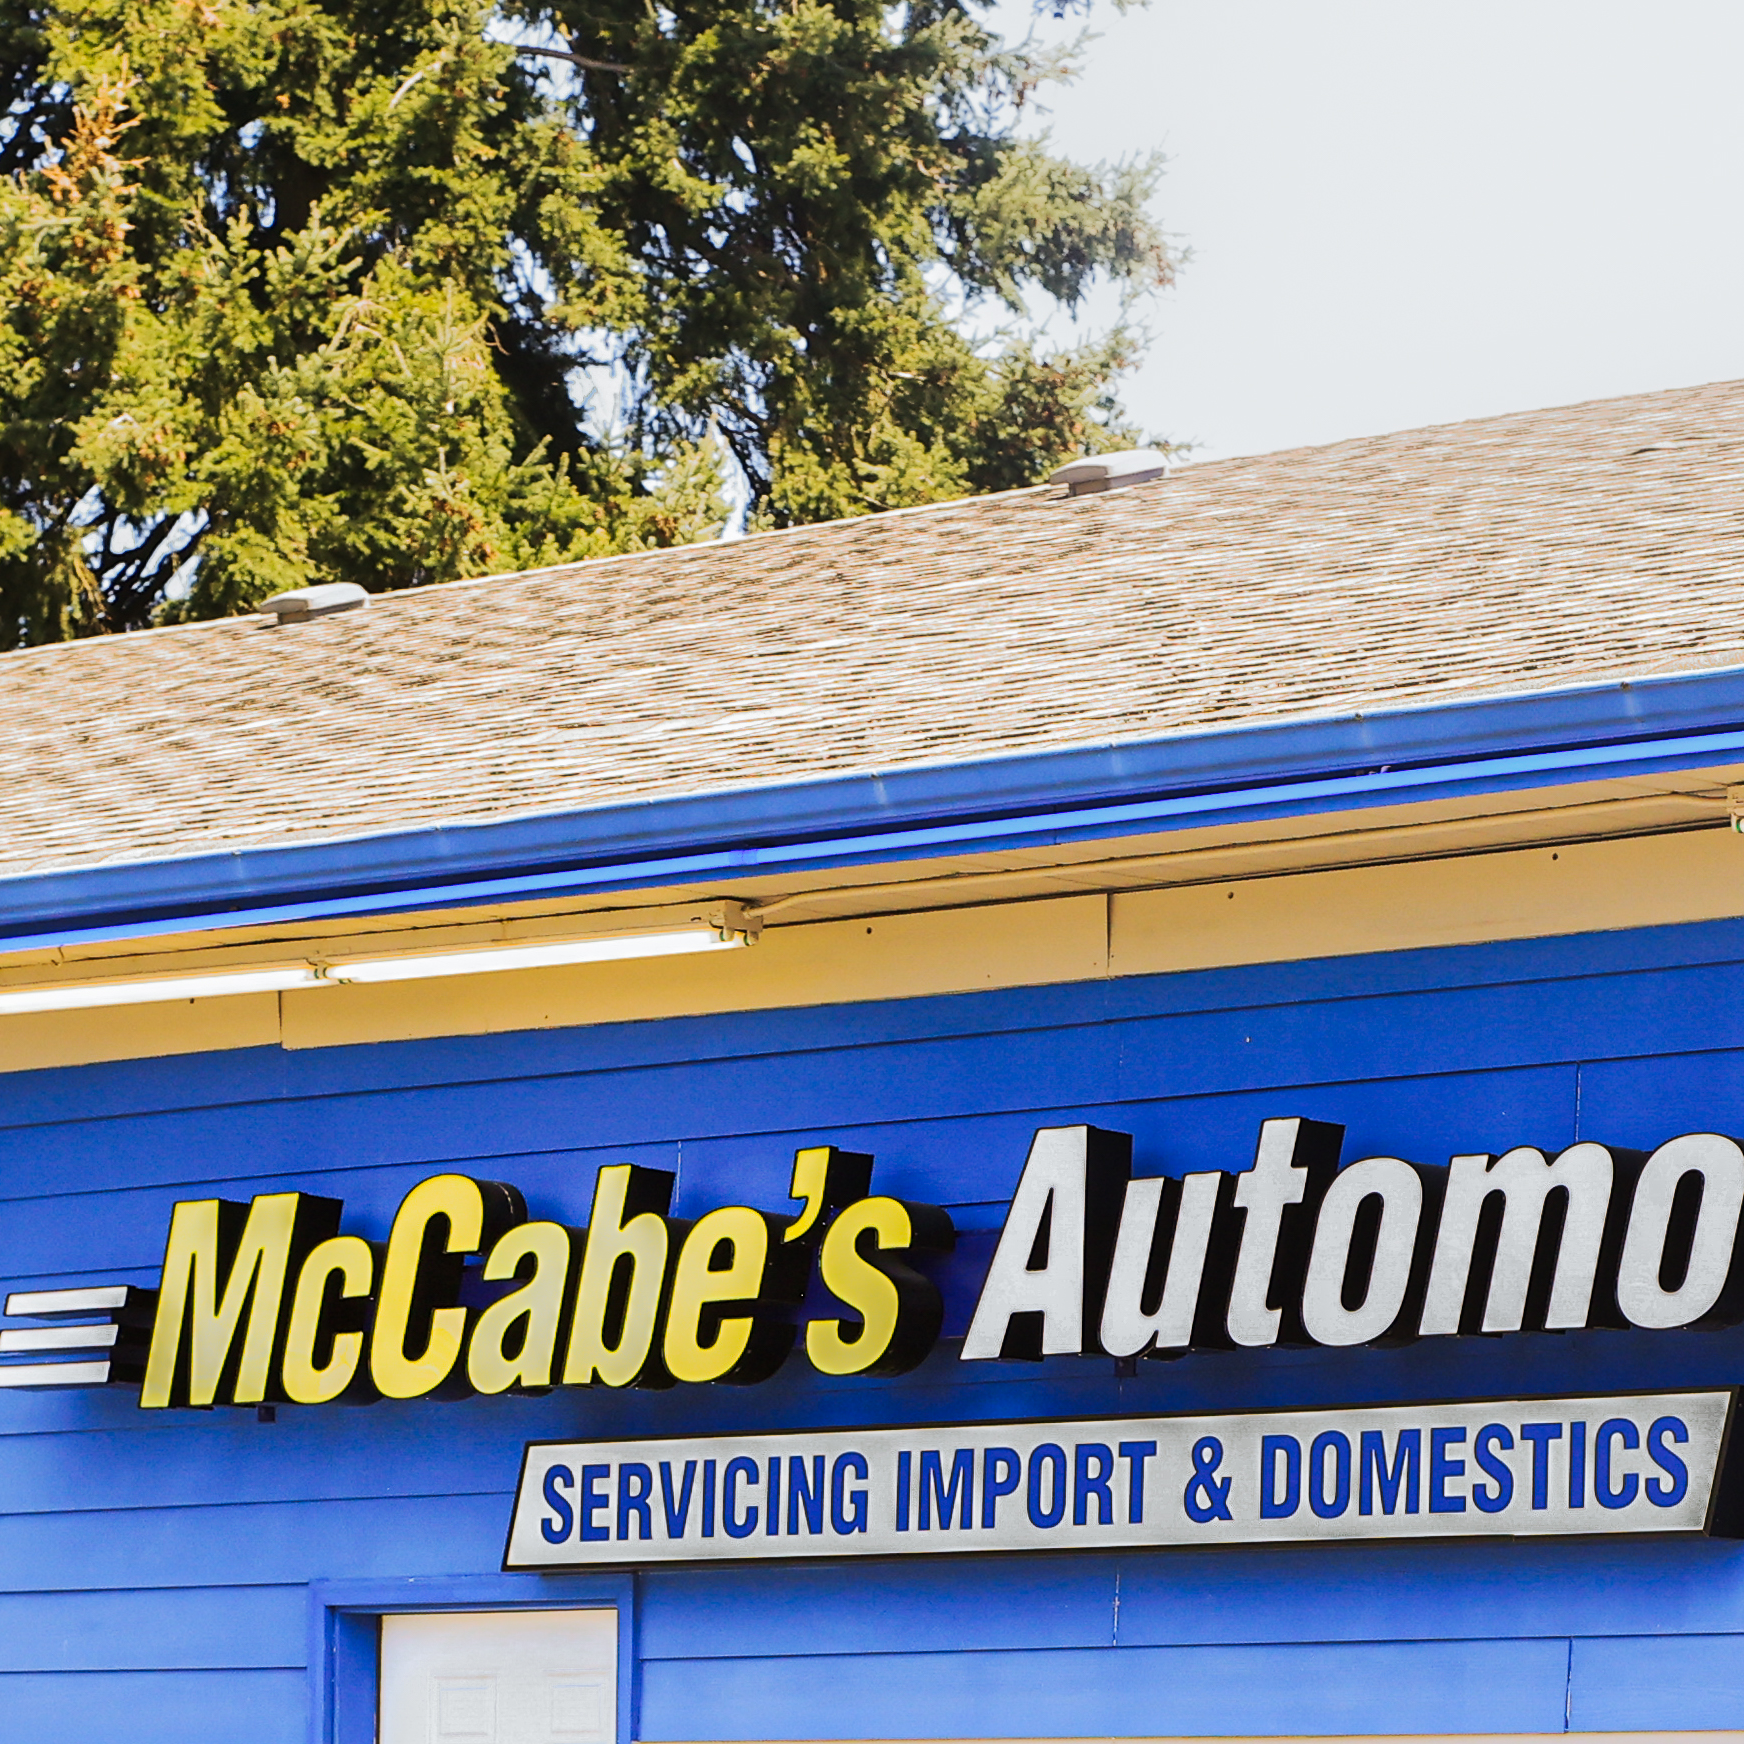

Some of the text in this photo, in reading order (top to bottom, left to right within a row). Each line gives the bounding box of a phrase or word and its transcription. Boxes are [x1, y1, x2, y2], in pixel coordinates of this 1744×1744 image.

[139, 1146, 913, 1409] McCabe's
[538, 1415, 1691, 1546] SERVICING IMPORT & DOMESTICS
